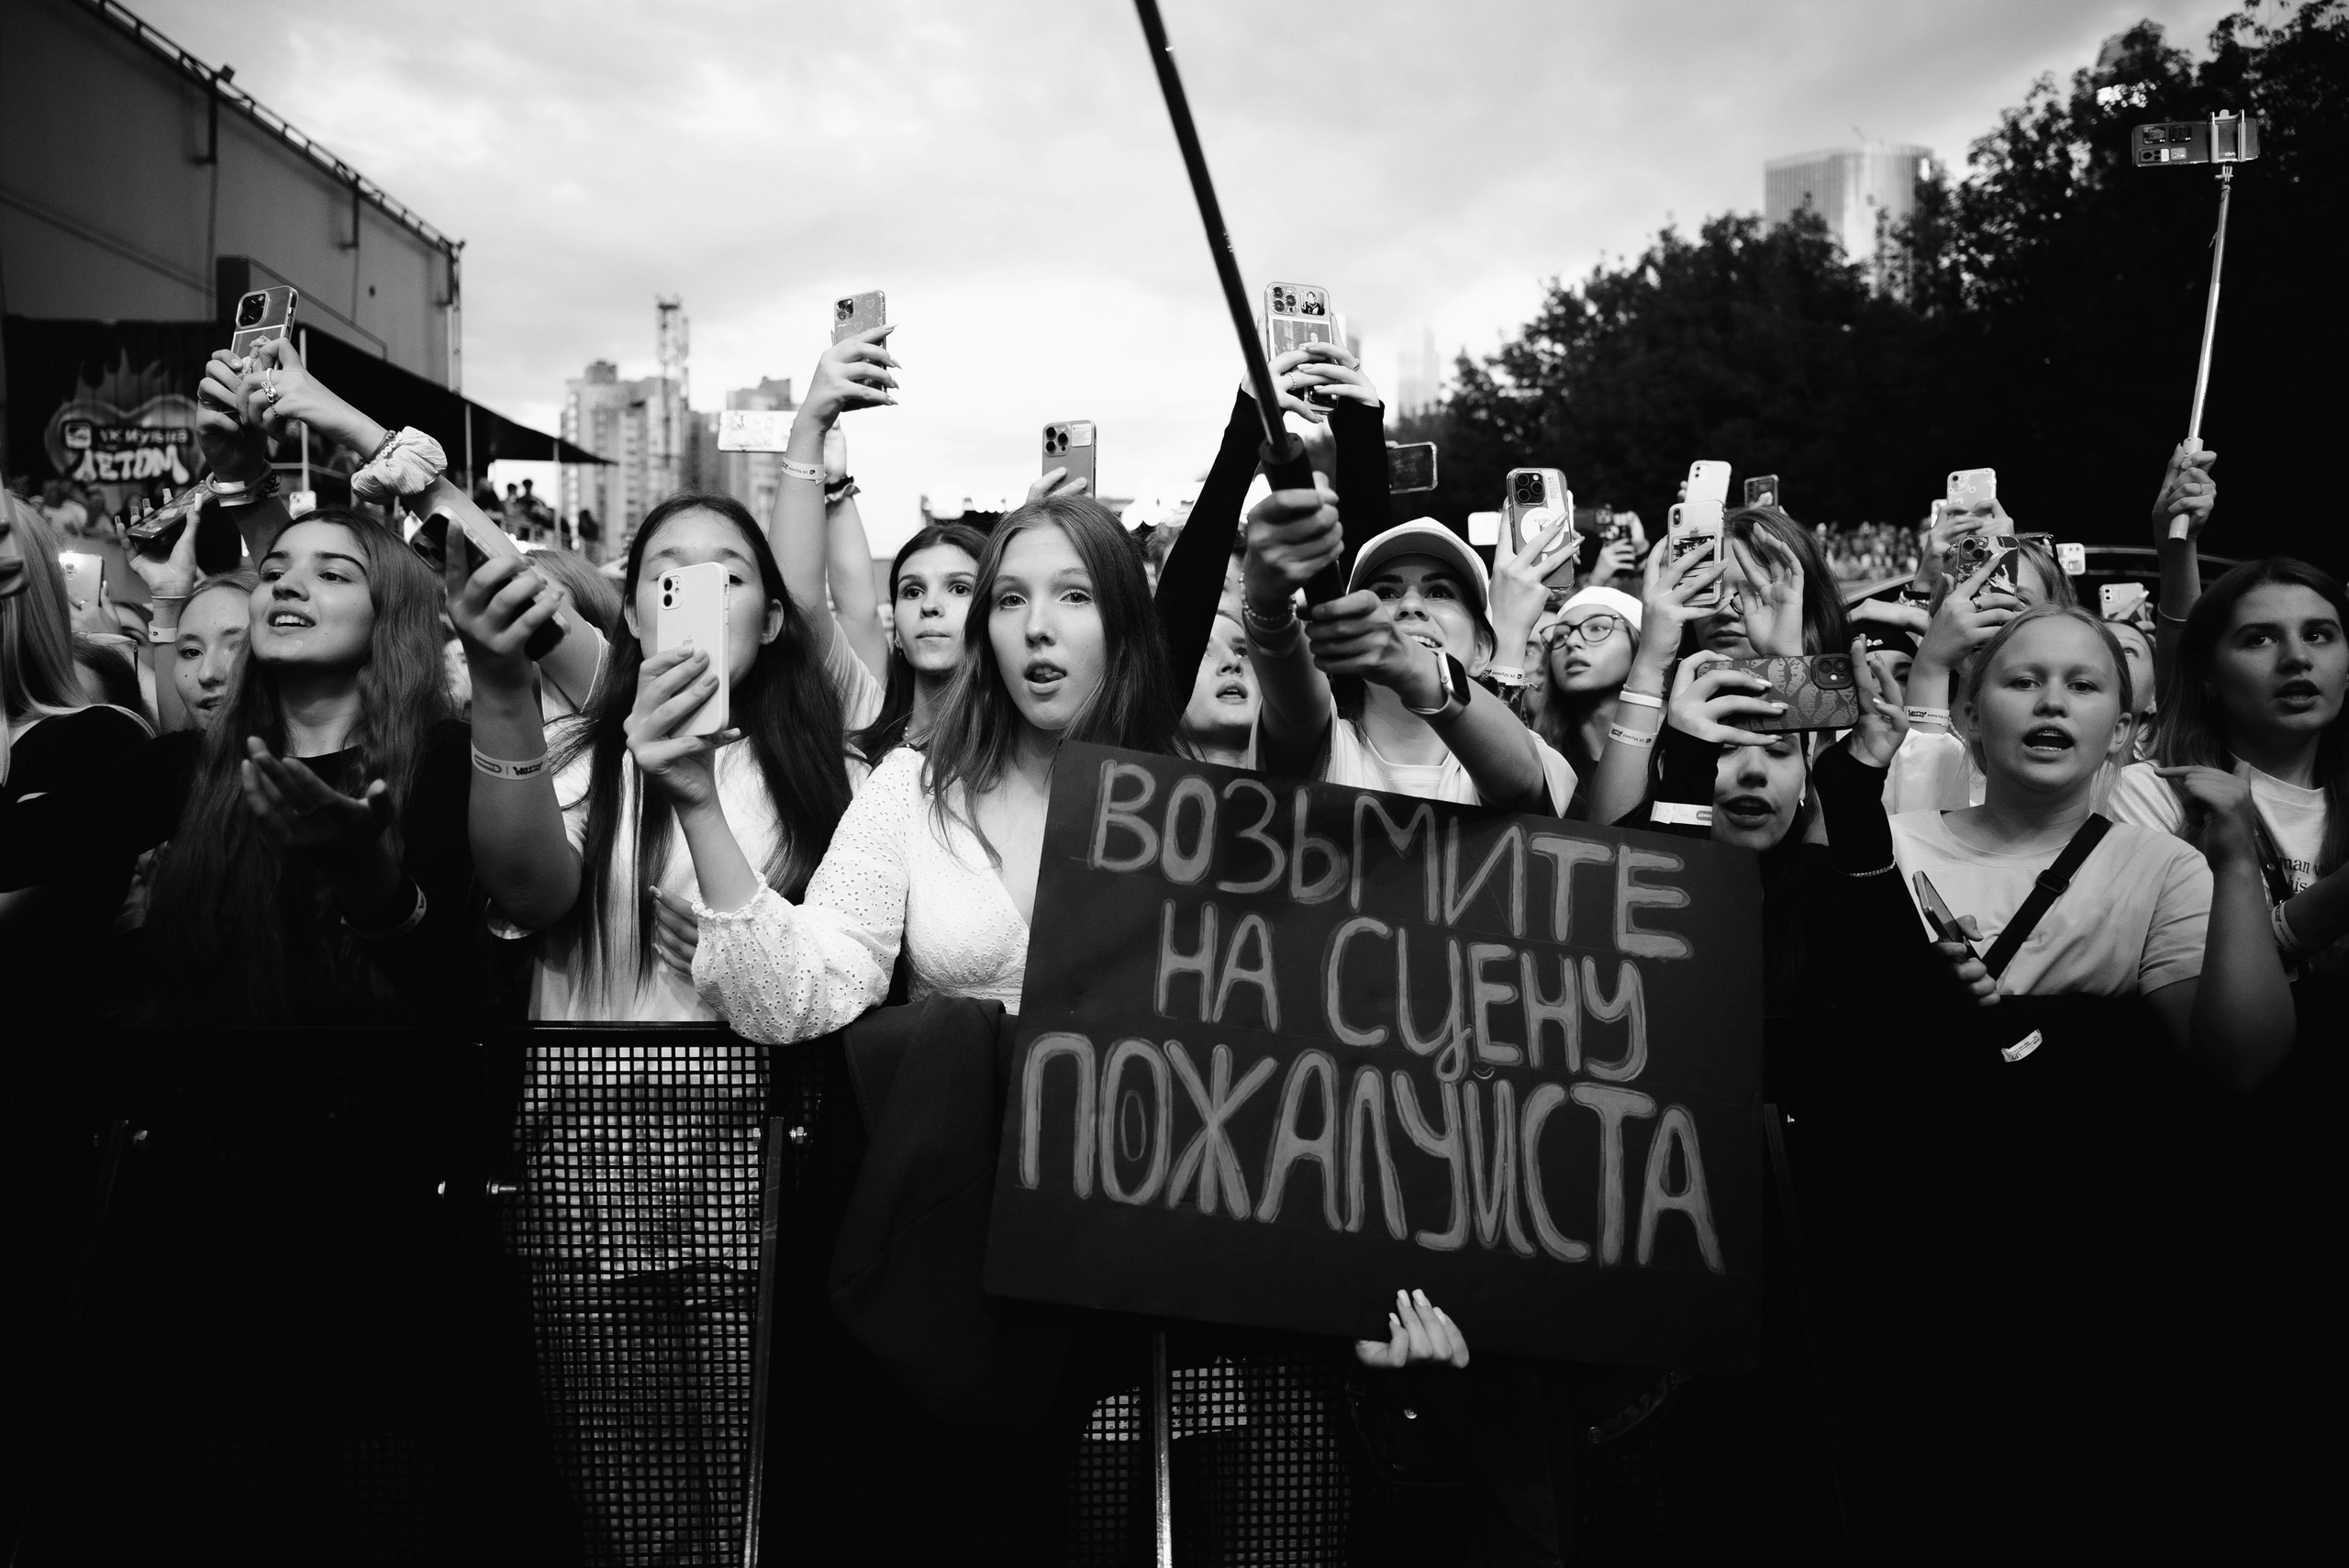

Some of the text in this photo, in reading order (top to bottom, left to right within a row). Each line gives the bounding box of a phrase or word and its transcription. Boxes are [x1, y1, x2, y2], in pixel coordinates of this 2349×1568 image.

[72, 444, 190, 484] ЛЕТОМ
[1092, 760, 1693, 959] ВОЗЬМИТЕ
[1156, 901, 1280, 1030] НА
[1326, 917, 1648, 1083] СЦЕНУ
[1020, 1032, 1723, 1273] ПОЖАЛУЙСТА
